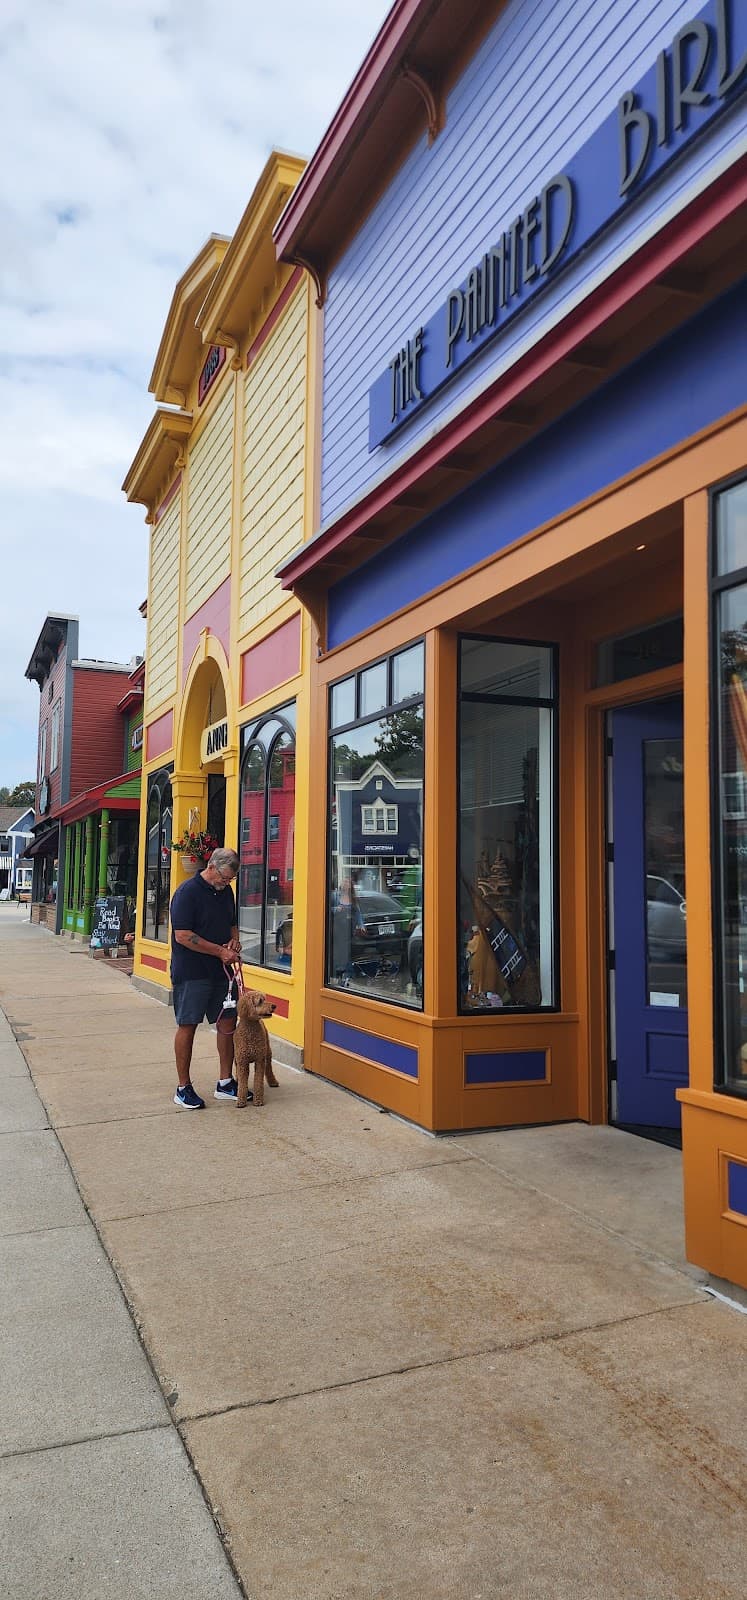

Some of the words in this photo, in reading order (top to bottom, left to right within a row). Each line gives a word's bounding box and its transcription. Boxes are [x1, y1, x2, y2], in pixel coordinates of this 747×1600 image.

[389, 327, 425, 424] THE
[446, 174, 575, 369] PAINTED
[100, 906, 116, 916] Read
